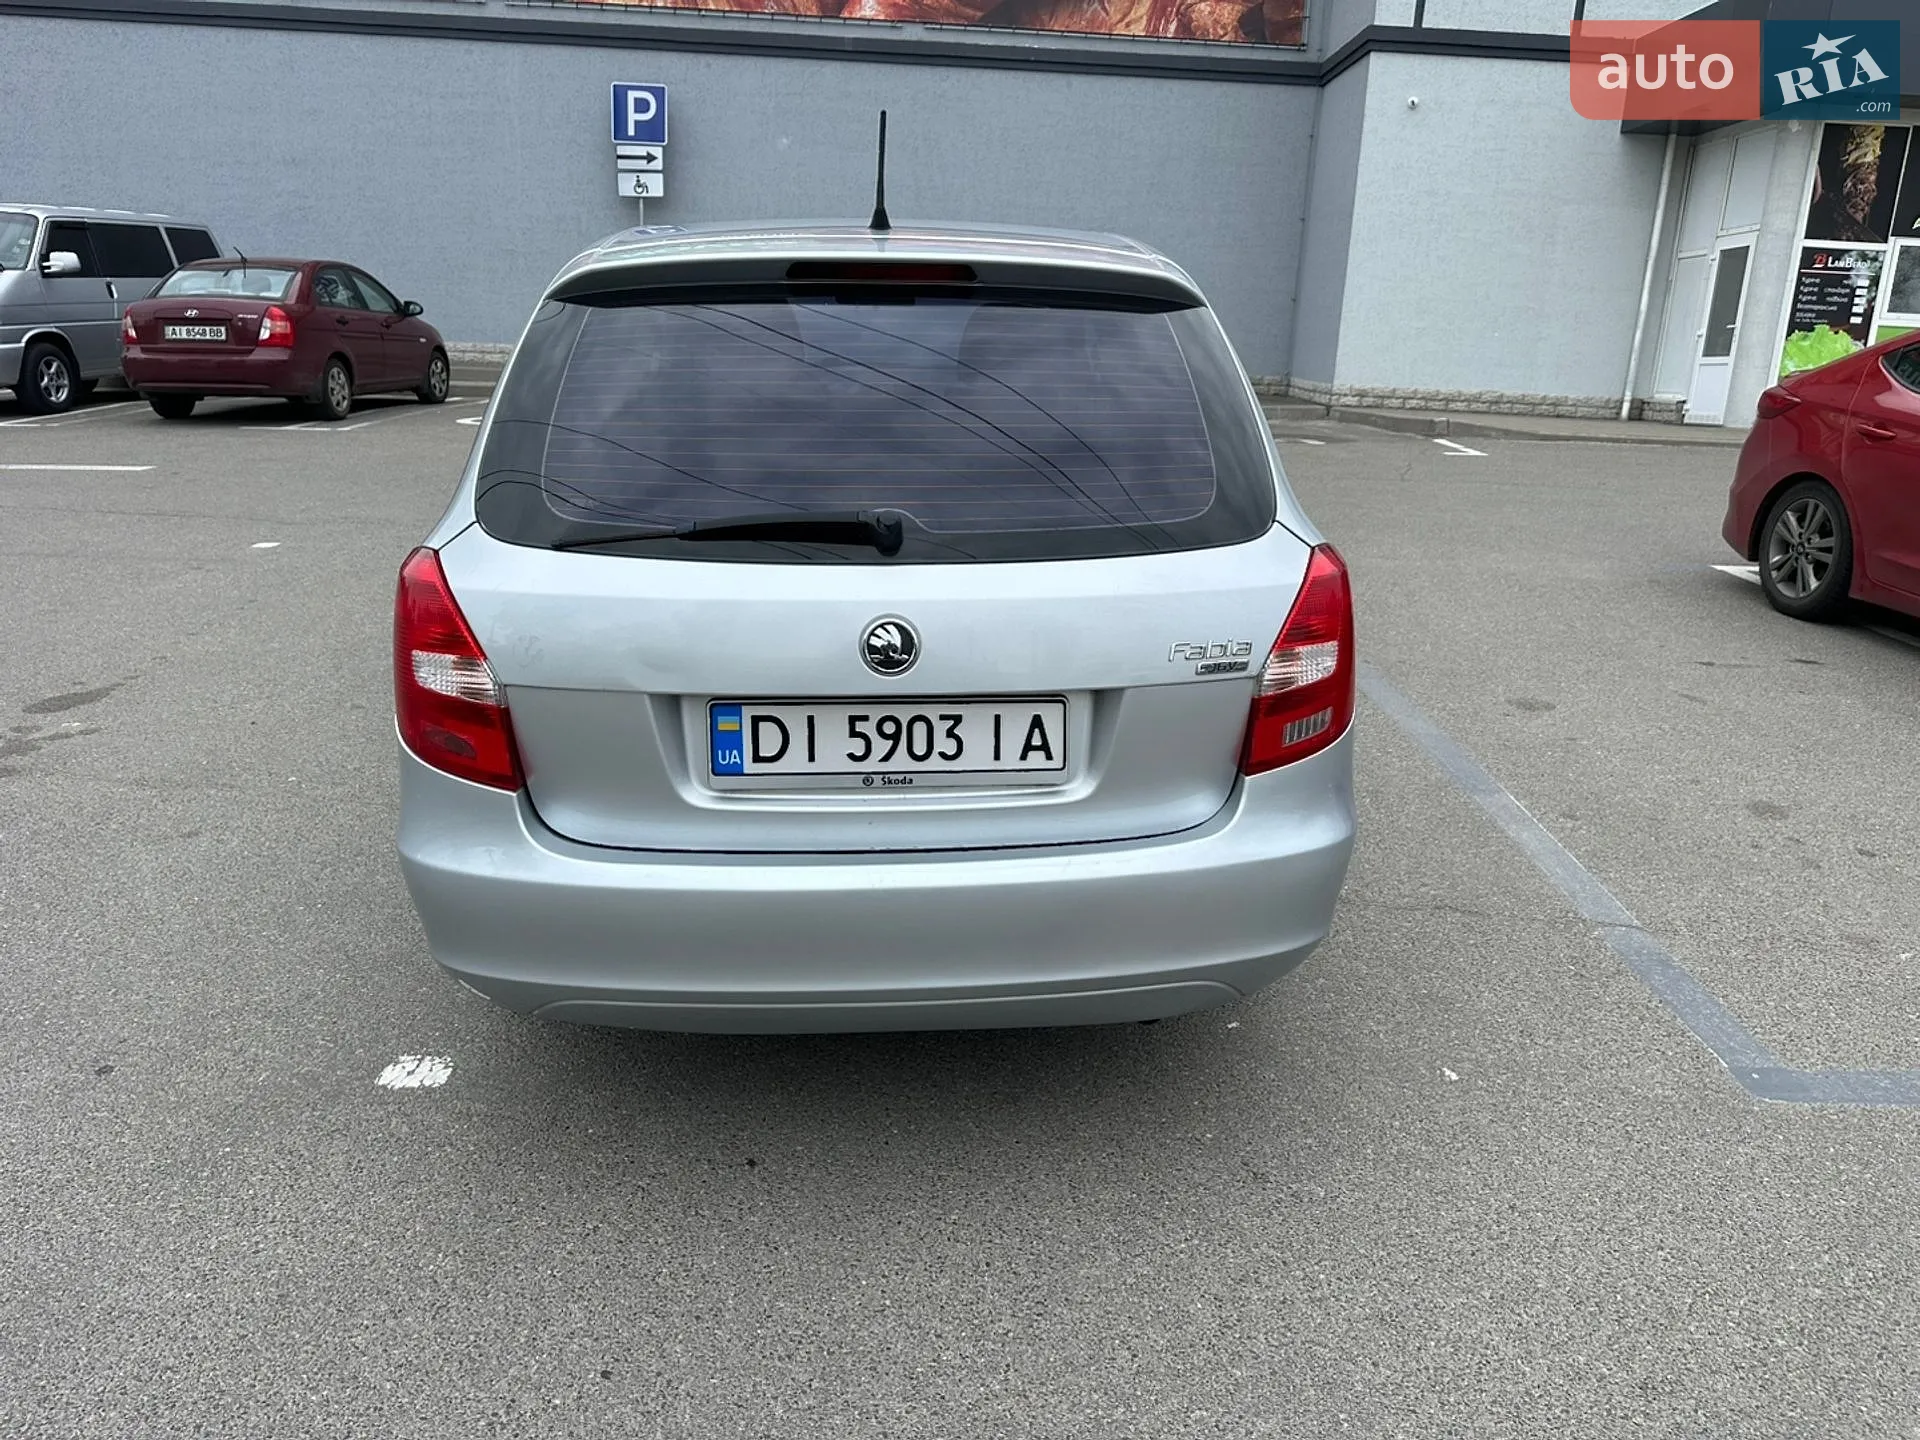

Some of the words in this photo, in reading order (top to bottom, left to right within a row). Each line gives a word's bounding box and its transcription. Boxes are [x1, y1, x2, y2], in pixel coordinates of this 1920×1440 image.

[627, 90, 657, 136] P
[170, 327, 183, 337] AI
[185, 327, 206, 337] 8548
[209, 327, 223, 337] BB
[1168, 638, 1252, 662] Fabia
[751, 714, 815, 764] DI
[846, 714, 964, 763] 5903
[993, 713, 1054, 761] IA
[718, 750, 741, 765] UA
